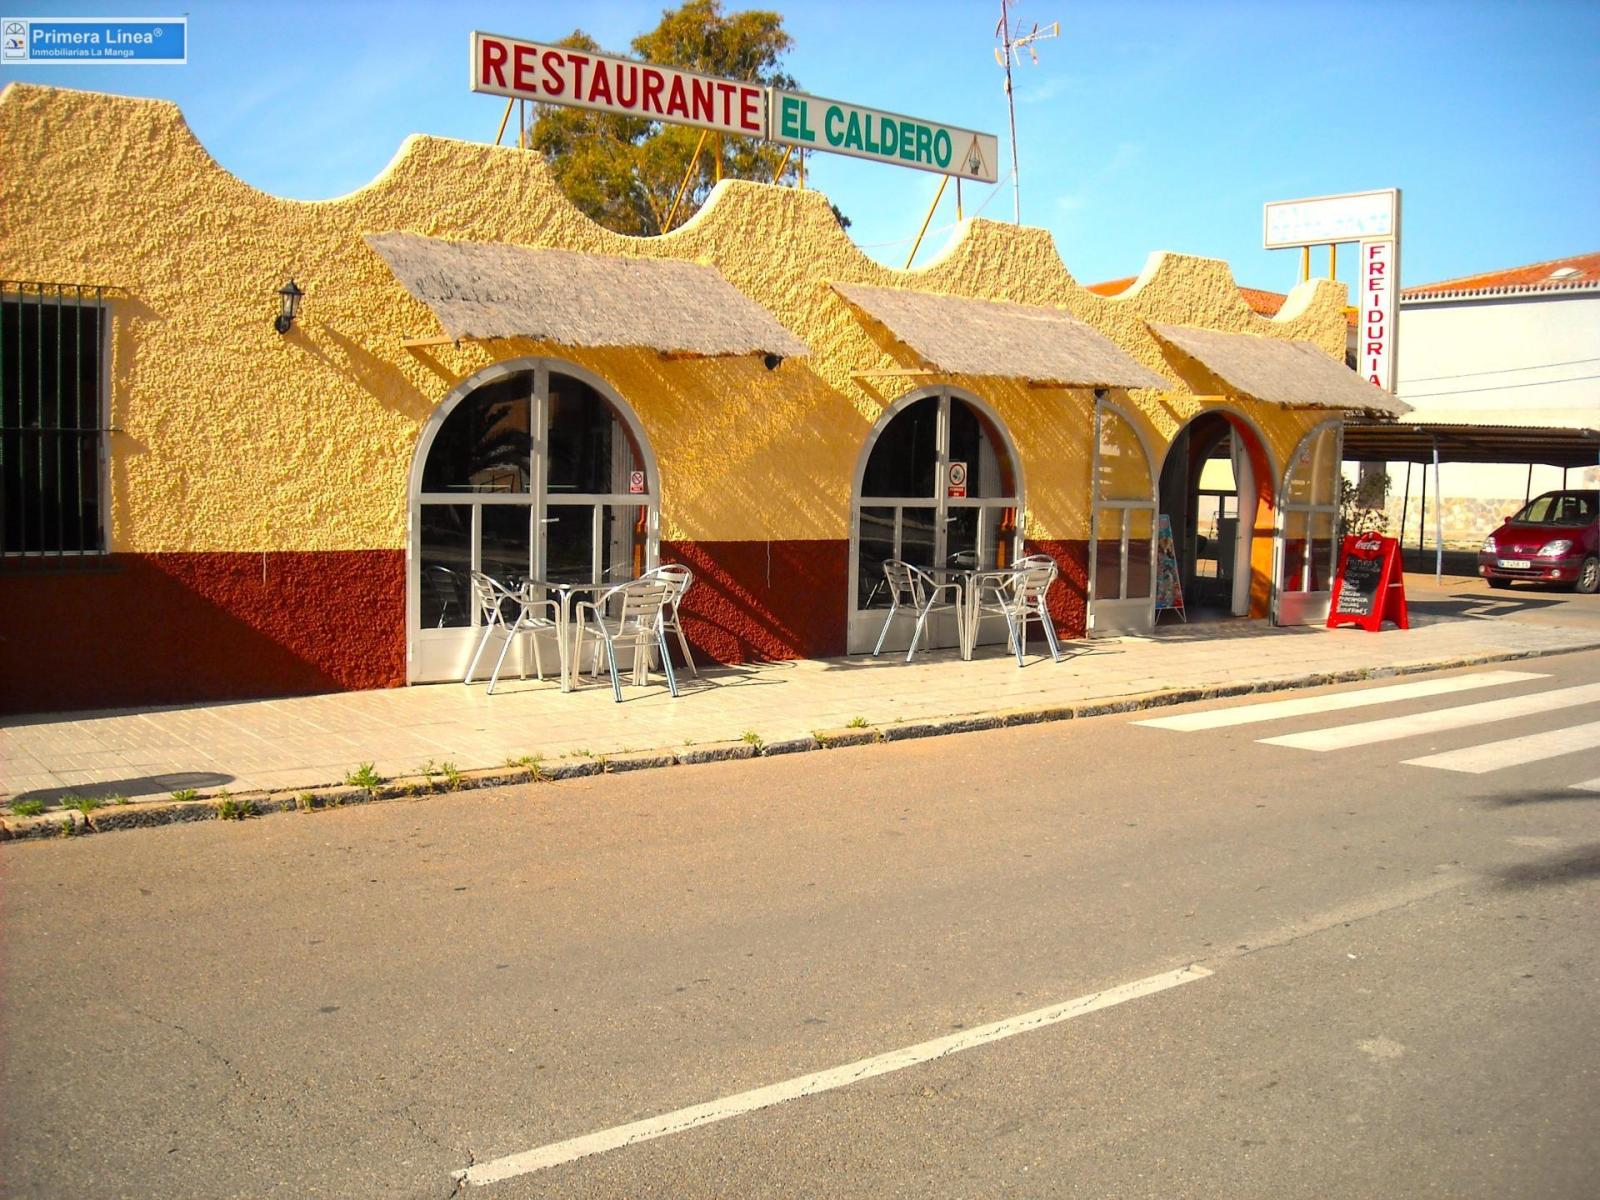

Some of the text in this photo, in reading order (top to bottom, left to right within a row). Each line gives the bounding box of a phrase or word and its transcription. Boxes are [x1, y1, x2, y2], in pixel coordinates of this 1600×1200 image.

[482, 39, 760, 131] RESTAURANTE
[781, 96, 953, 169] EL CALDERO
[1367, 245, 1385, 387] FREIDURIA
